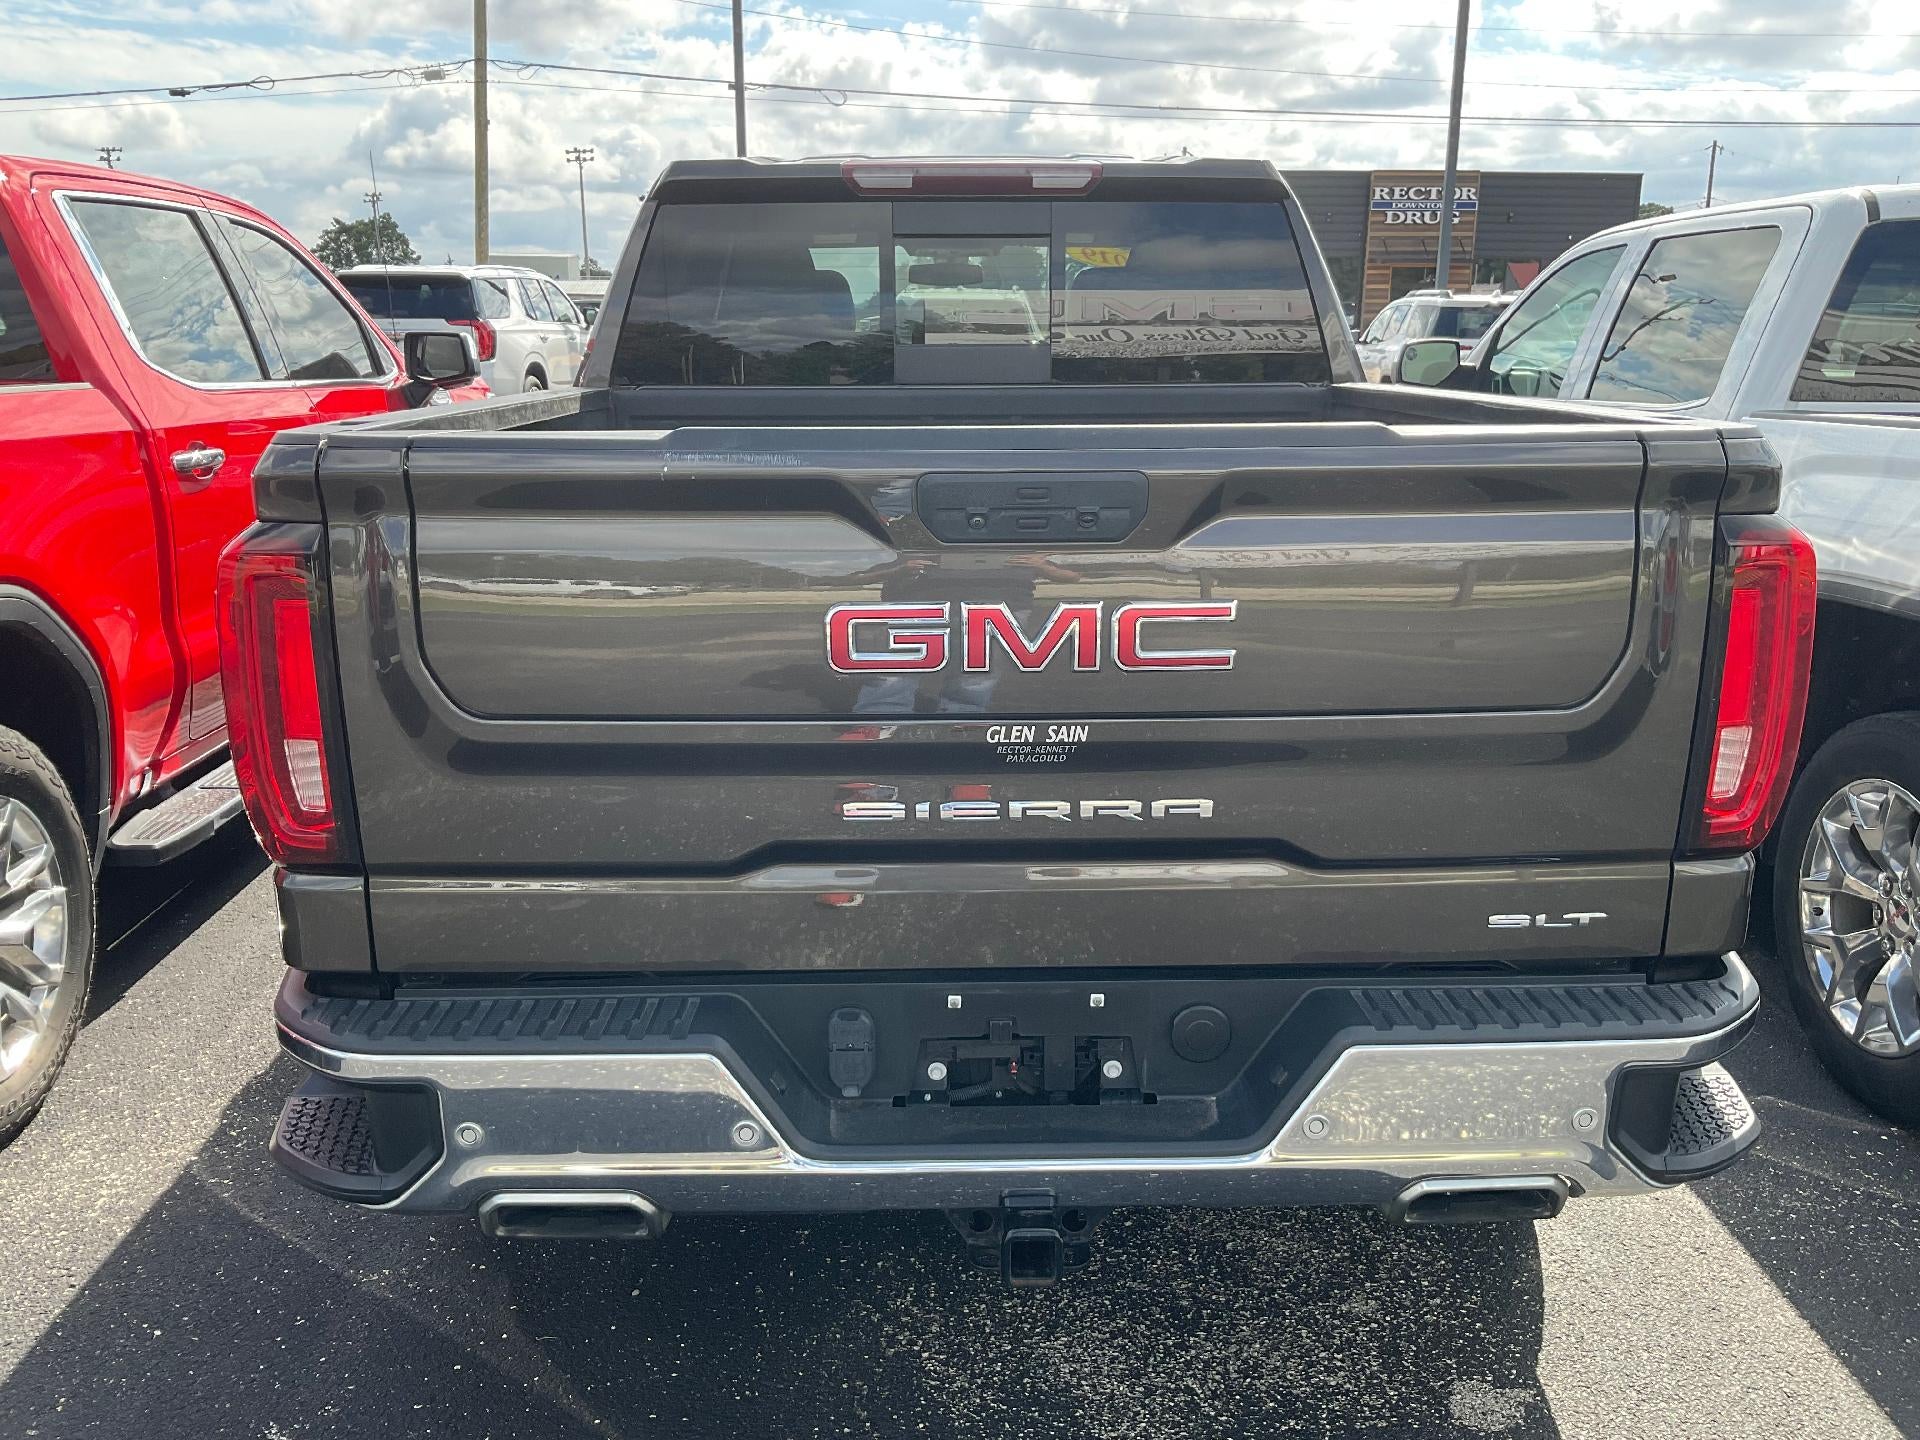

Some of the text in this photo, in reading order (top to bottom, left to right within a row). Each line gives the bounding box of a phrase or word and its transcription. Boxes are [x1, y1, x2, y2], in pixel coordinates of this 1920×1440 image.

[824, 600, 1238, 673] GMC
[986, 725, 1089, 743] GLEN SAIN
[997, 745, 1077, 754] RECTOR-KENNETT
[1006, 754, 1067, 763] PARAGOULD
[842, 799, 1214, 822] SIERRA
[1487, 912, 1608, 928] SLT
